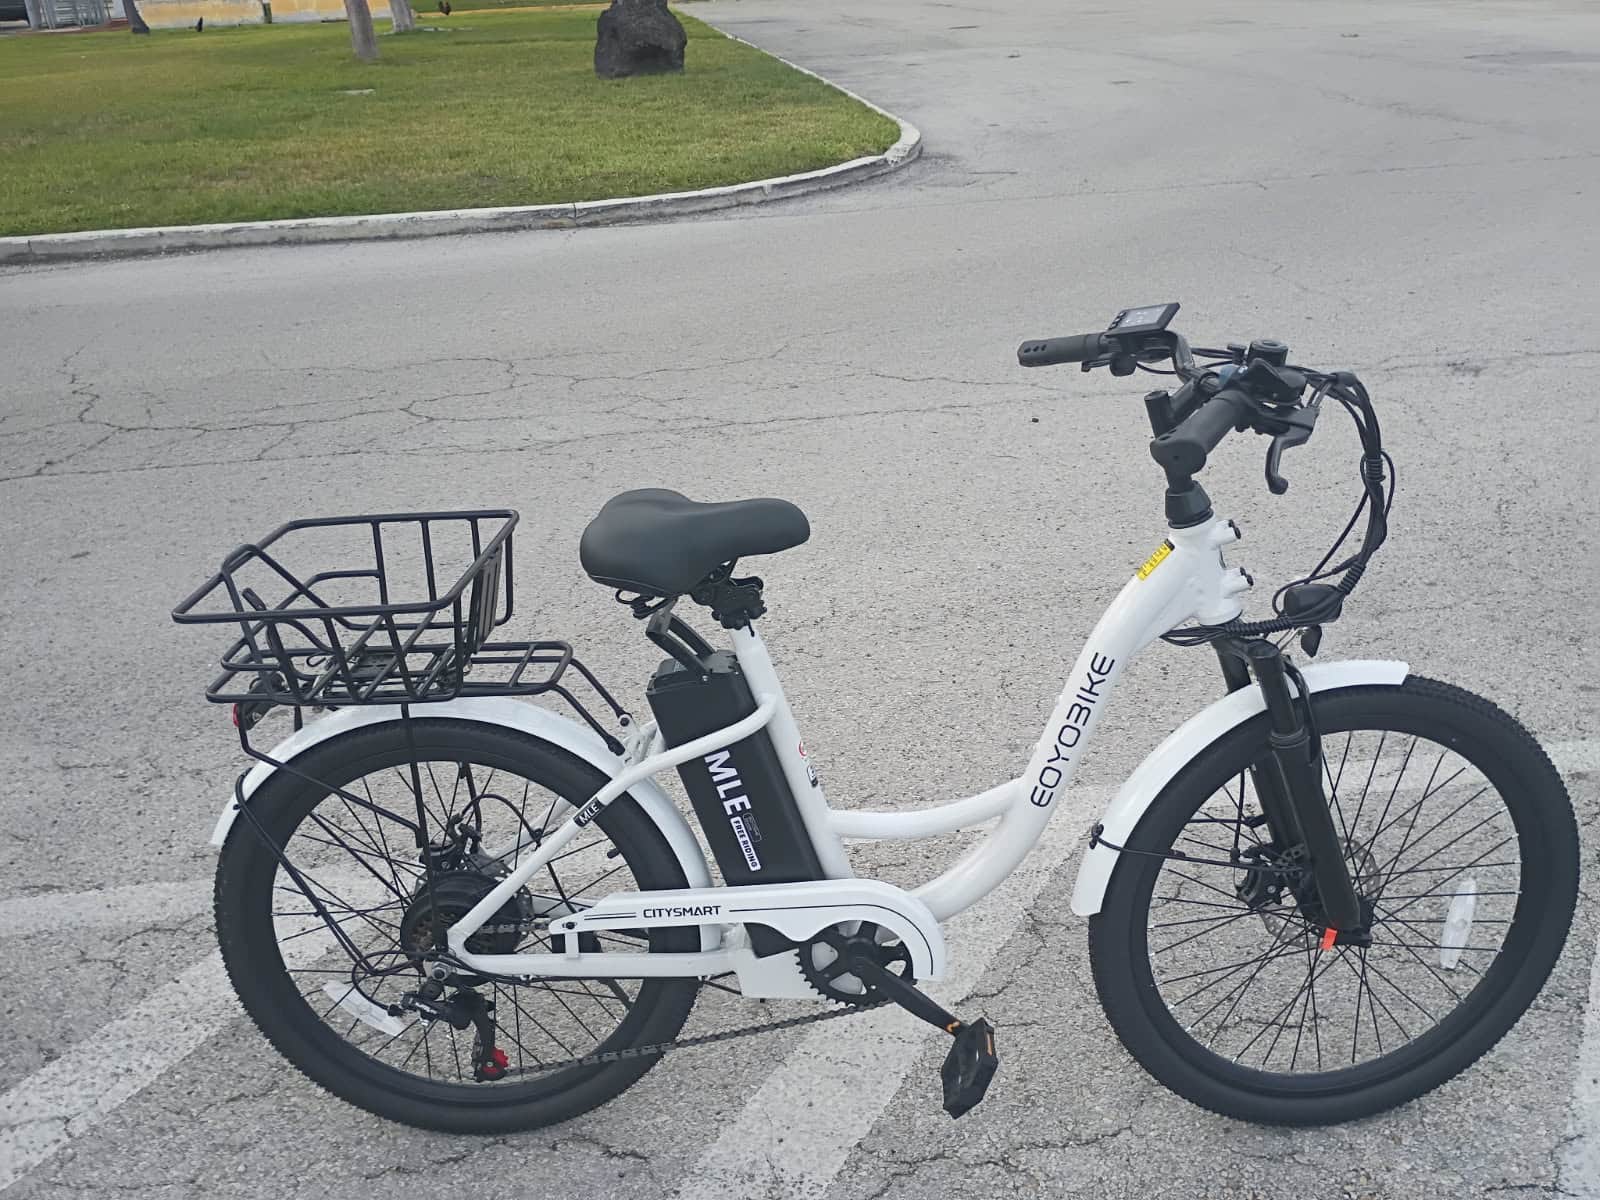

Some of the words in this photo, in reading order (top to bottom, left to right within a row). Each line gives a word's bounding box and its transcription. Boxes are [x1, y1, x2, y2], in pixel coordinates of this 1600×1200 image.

[1030, 652, 1115, 808] EOYOBIKE
[704, 750, 752, 816] MLE
[578, 802, 600, 824] MLE
[733, 820, 746, 840] FREE
[742, 839, 758, 868] RIDING
[643, 905, 721, 919] CITYSMART
